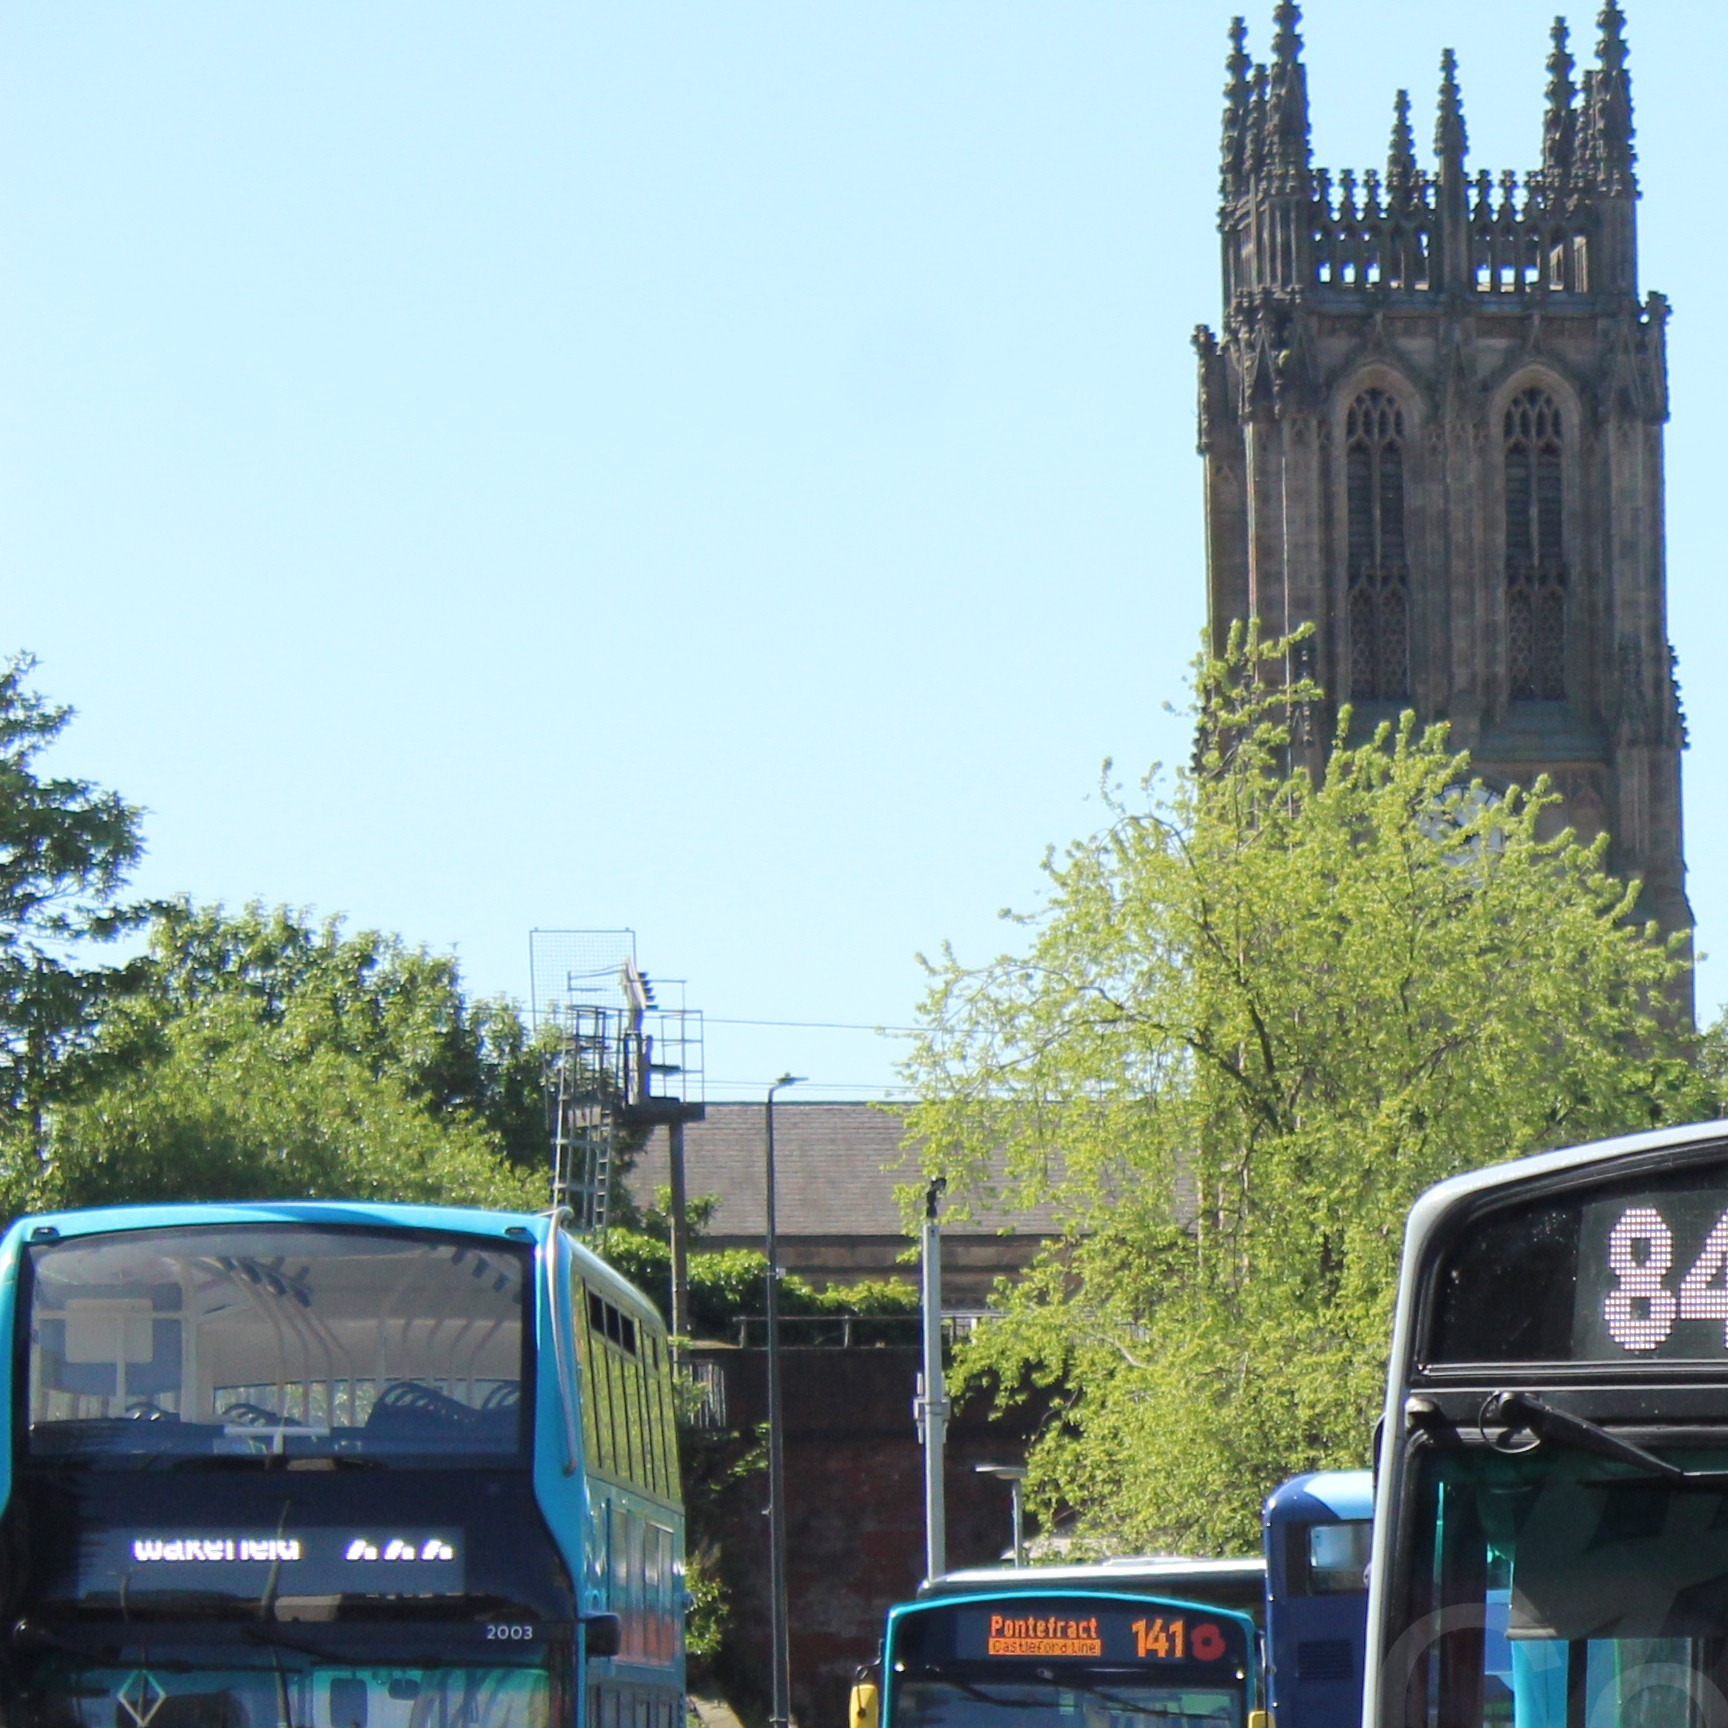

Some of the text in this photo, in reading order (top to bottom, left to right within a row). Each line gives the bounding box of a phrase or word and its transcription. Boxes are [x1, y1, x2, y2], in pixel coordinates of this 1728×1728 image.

[486, 1625, 533, 1640] 2003
[990, 1615, 1185, 1658] Pontefract 141
[992, 1639, 1067, 1655] Castleford
